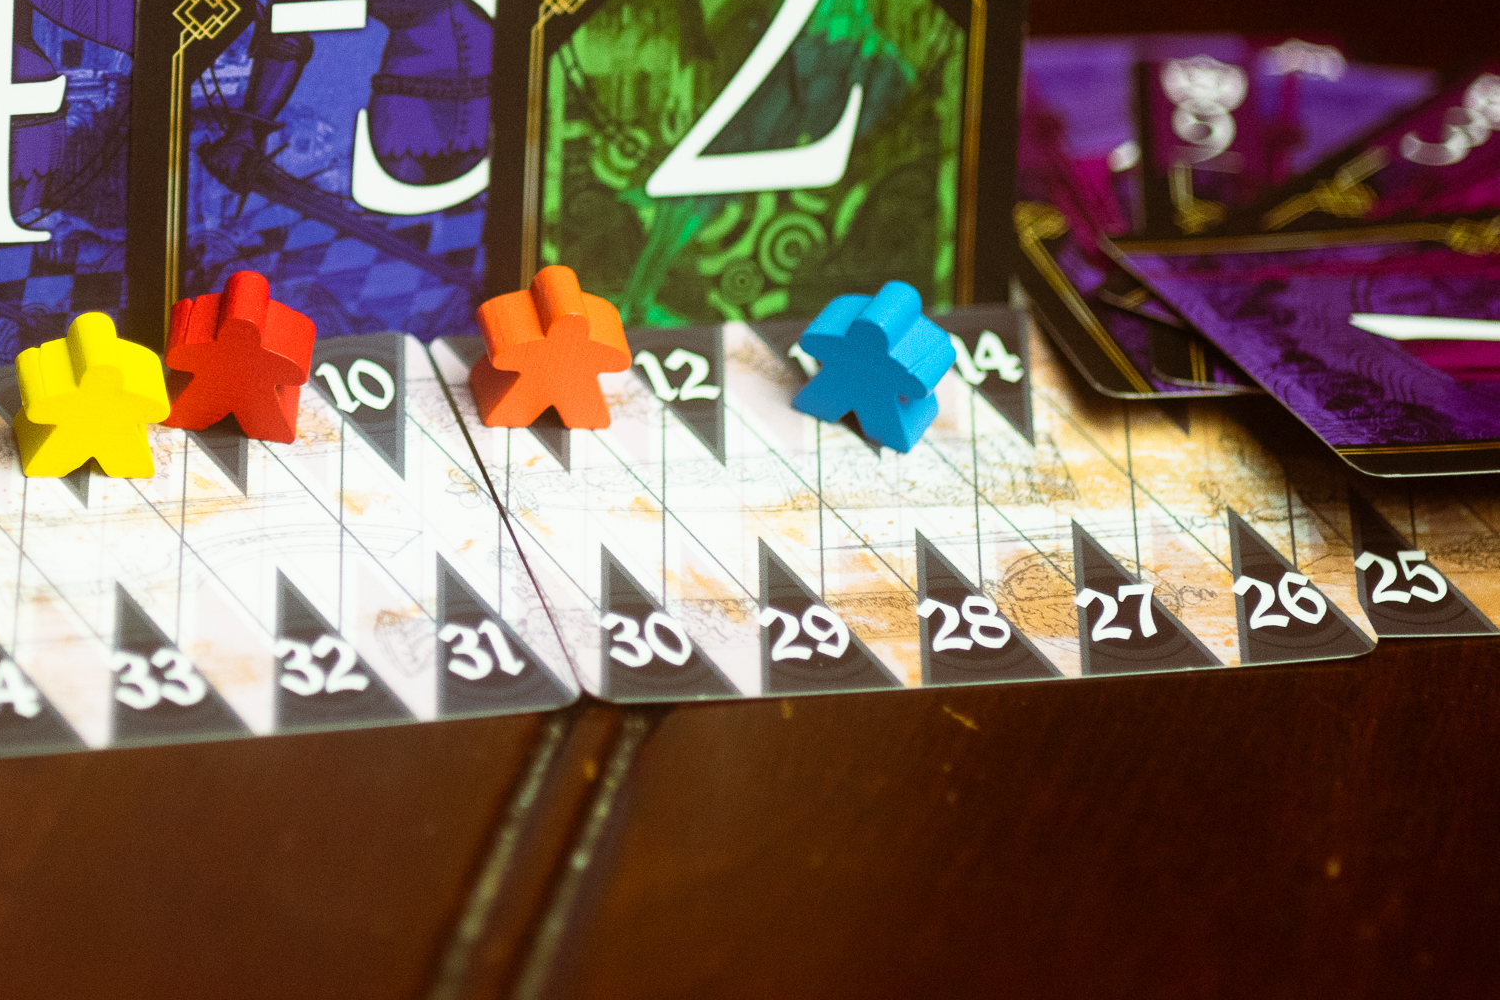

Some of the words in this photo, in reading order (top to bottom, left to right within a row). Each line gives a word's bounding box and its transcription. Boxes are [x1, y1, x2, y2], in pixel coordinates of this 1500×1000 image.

[315, 358, 396, 413] 10
[634, 348, 722, 402] 12
[948, 330, 1025, 387] 14
[1231, 571, 1328, 631] 26
[1354, 549, 1449, 606] 25
[600, 610, 693, 668] 30
[758, 602, 851, 662] 29
[916, 594, 1012, 652] 28
[1076, 583, 1155, 641] 27
[109, 648, 206, 709] 33
[274, 633, 369, 694] 32
[439, 619, 525, 680] 31
